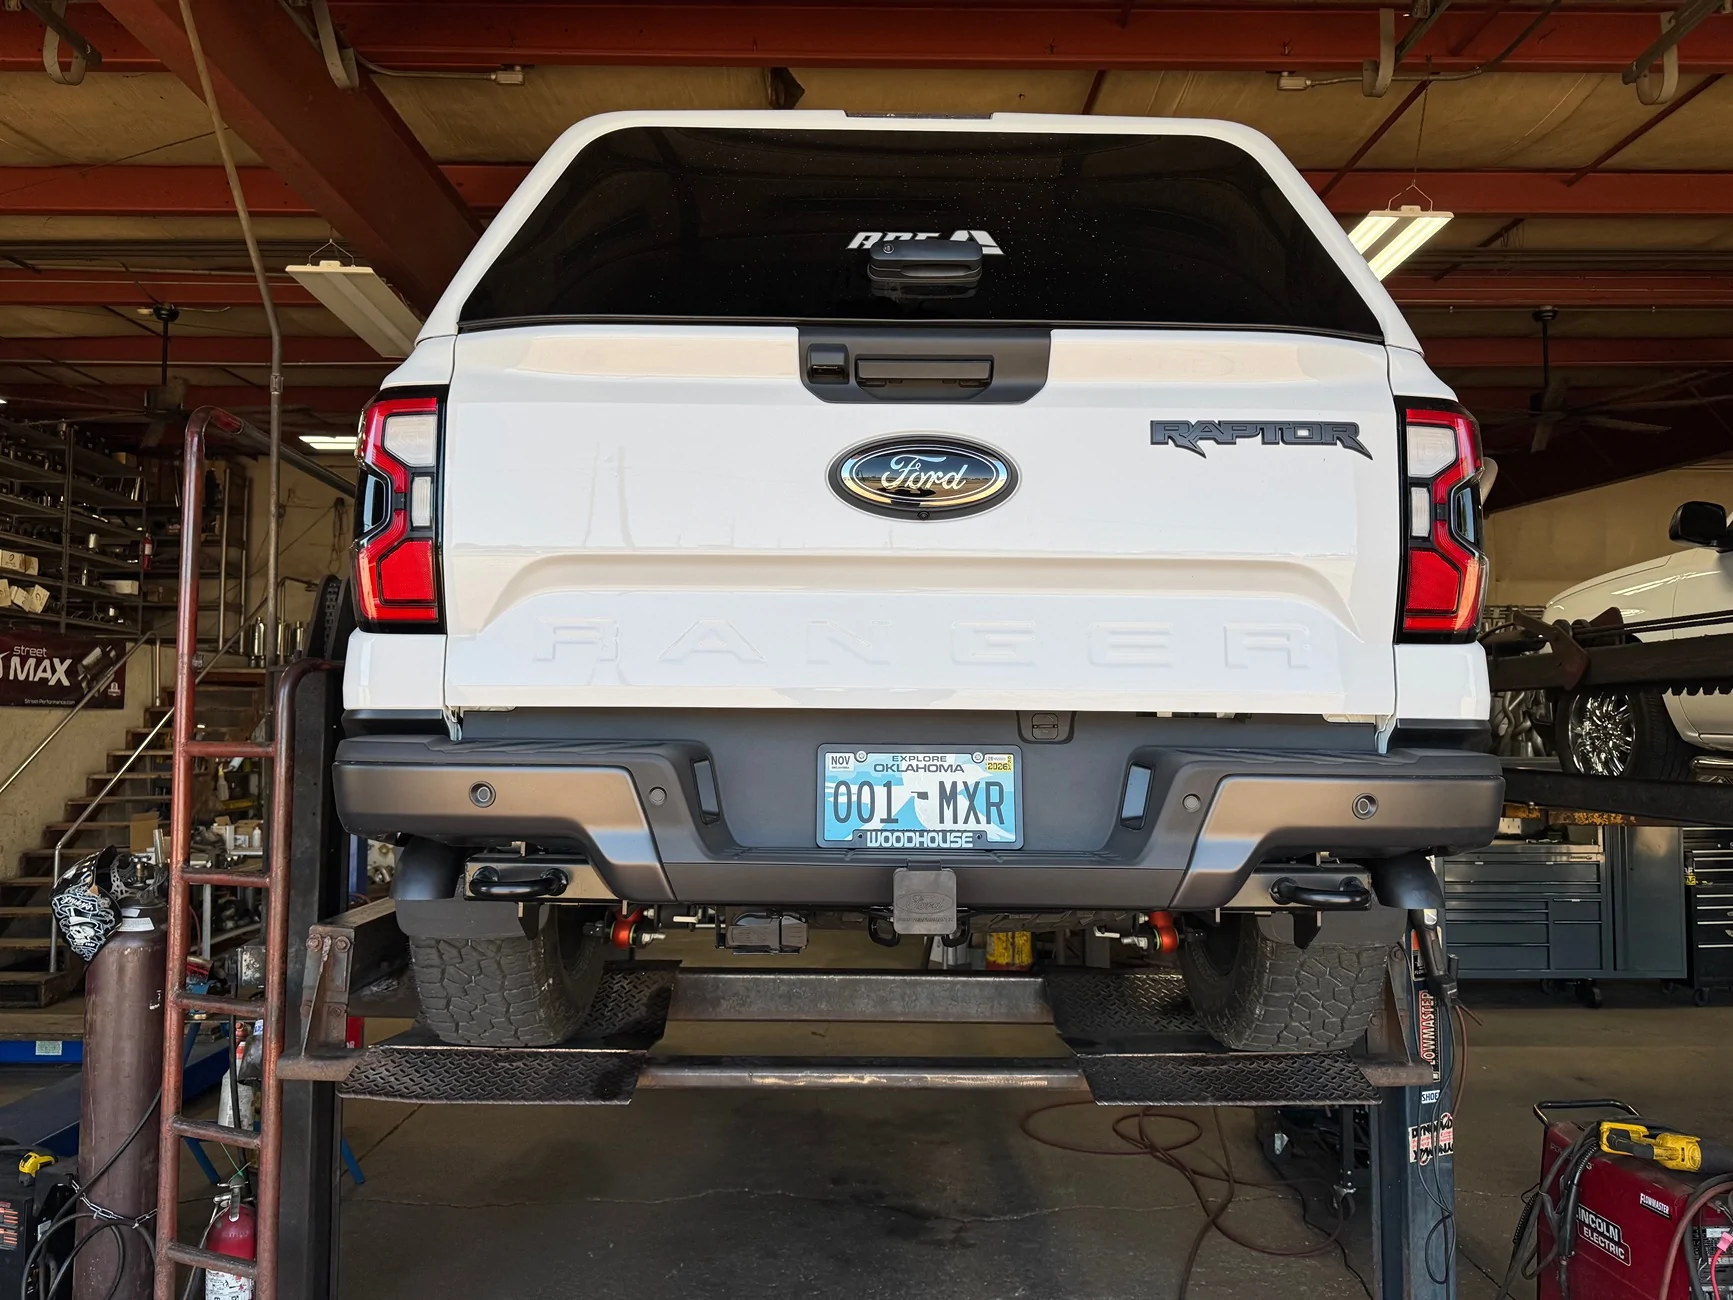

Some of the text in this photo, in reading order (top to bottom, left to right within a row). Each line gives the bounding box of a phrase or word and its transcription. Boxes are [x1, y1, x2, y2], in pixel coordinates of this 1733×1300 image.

[1150, 420, 1373, 460] RAPTOR
[880, 454, 969, 490] Ford
[13, 645, 48, 658] street
[532, 617, 1312, 669] RANGER
[9, 656, 73, 687] MAX
[831, 755, 851, 766] NOV
[873, 763, 965, 773] OKLAHOMA
[892, 755, 947, 763] EXPLORE
[987, 762, 1008, 771] 2026
[833, 780, 1005, 825] 001 MXR
[866, 831, 973, 848] WOODHOUSE
[1640, 1193, 1670, 1214] FLOWMASTER
[1576, 1206, 1619, 1242] INCOLN
[1583, 1227, 1625, 1260] ELECTRIC
